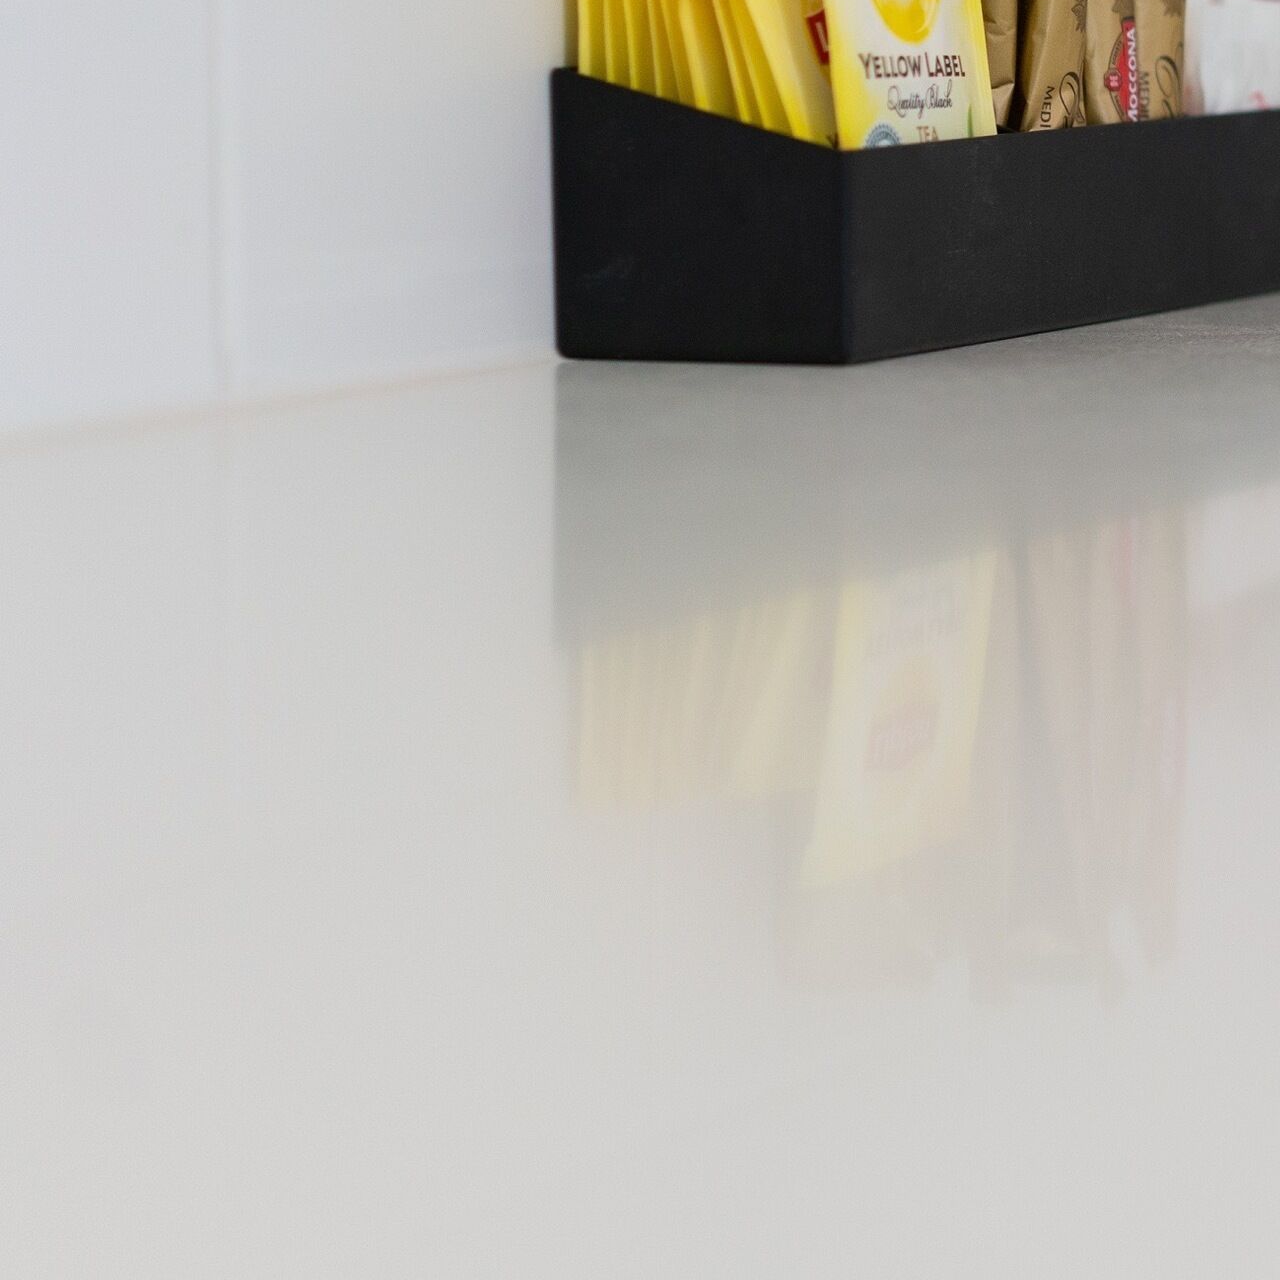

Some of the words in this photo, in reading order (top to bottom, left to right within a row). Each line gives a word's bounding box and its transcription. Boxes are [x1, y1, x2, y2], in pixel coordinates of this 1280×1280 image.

[859, 52, 921, 78] YELLOW
[924, 51, 966, 78] LABEL
[887, 85, 925, 120] Quality
[925, 79, 953, 110] Black
